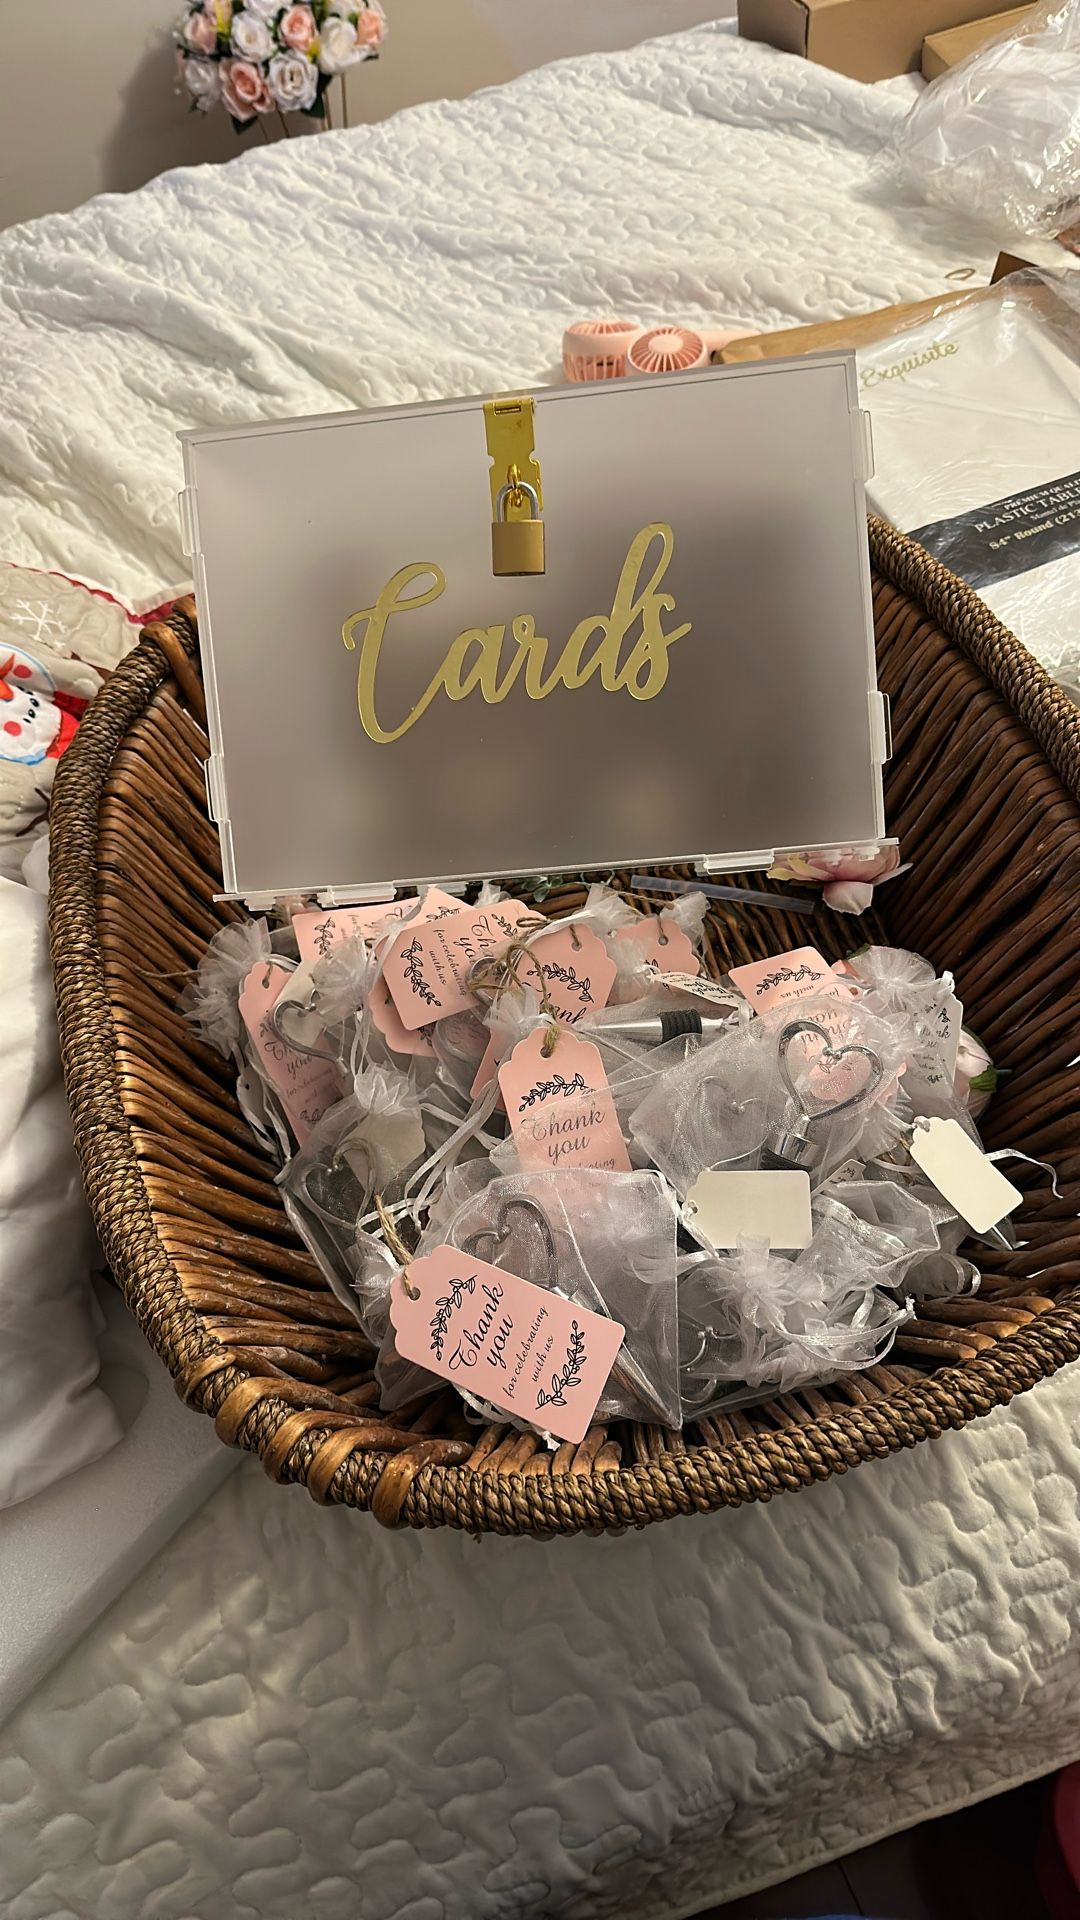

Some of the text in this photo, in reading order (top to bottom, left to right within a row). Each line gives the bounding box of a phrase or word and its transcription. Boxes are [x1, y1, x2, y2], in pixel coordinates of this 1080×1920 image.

[860, 340, 960, 388] Exquisite
[1003, 478, 1080, 511] PREMIUM QUALI
[974, 504, 1038, 532] PLASTIC
[989, 535, 1011, 550] 84"
[1013, 520, 1054, 540] Round
[341, 522, 692, 743] Cards
[432, 928, 446, 944] for
[453, 937, 478, 965] yo
[429, 950, 448, 985] with us
[793, 984, 814, 998] with
[520, 1109, 606, 1142] Thank
[548, 1135, 591, 1166] you
[448, 1282, 504, 1370] Thank
[486, 1314, 514, 1370] you
[503, 1305, 549, 1399] for celebrating
[531, 1335, 554, 1383] with us
